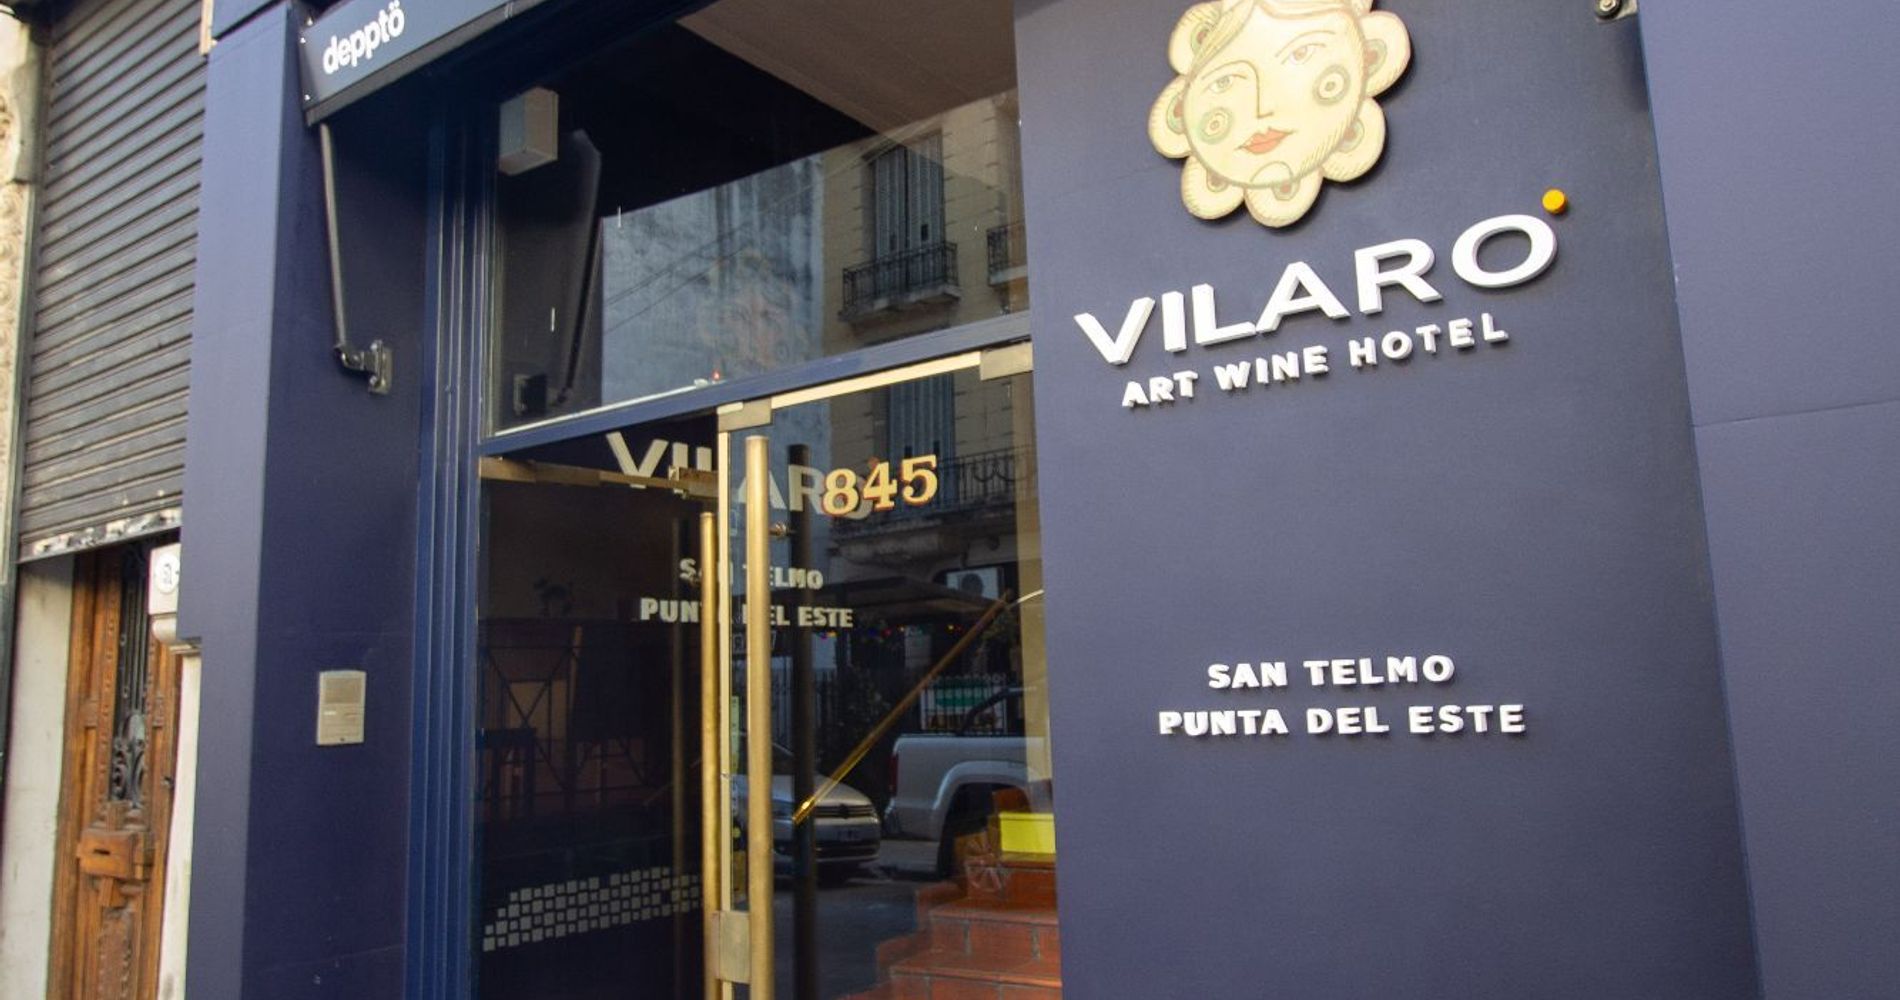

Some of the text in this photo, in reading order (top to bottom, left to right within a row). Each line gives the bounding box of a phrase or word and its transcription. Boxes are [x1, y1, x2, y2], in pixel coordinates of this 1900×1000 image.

[323, 0, 405, 75] depptö
[1074, 213, 1558, 365] VILARO
[1121, 312, 1509, 408] ART WINE HOTEL
[822, 454, 938, 518] 845
[797, 606, 854, 628] ESTE
[1207, 654, 1455, 689] SAN TELMO
[1159, 704, 1526, 736] PUNTA DEL ESTE
